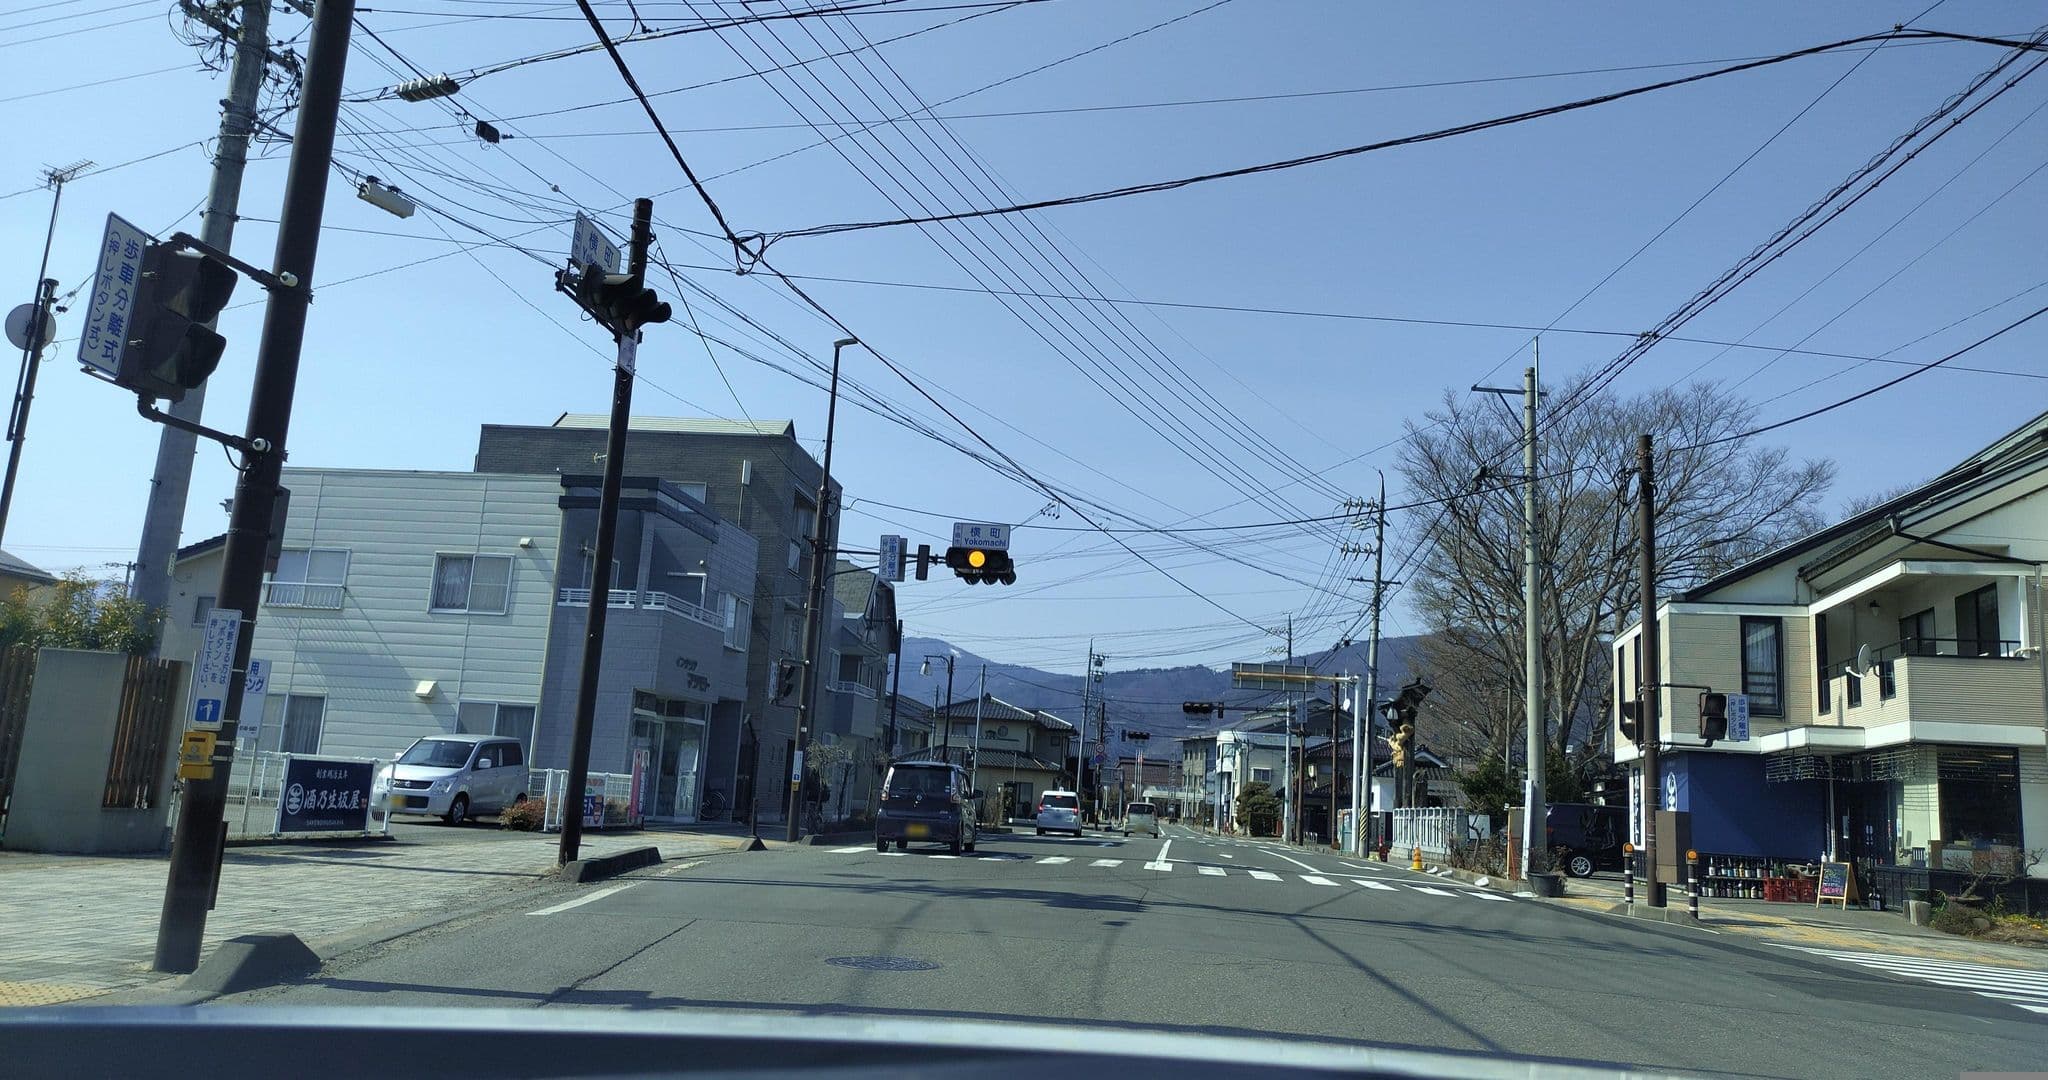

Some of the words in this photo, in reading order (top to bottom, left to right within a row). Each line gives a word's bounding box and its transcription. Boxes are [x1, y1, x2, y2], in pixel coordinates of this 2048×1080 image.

[101, 238, 139, 363] 歩車分離式
[964, 537, 1007, 548] Yokomachi
